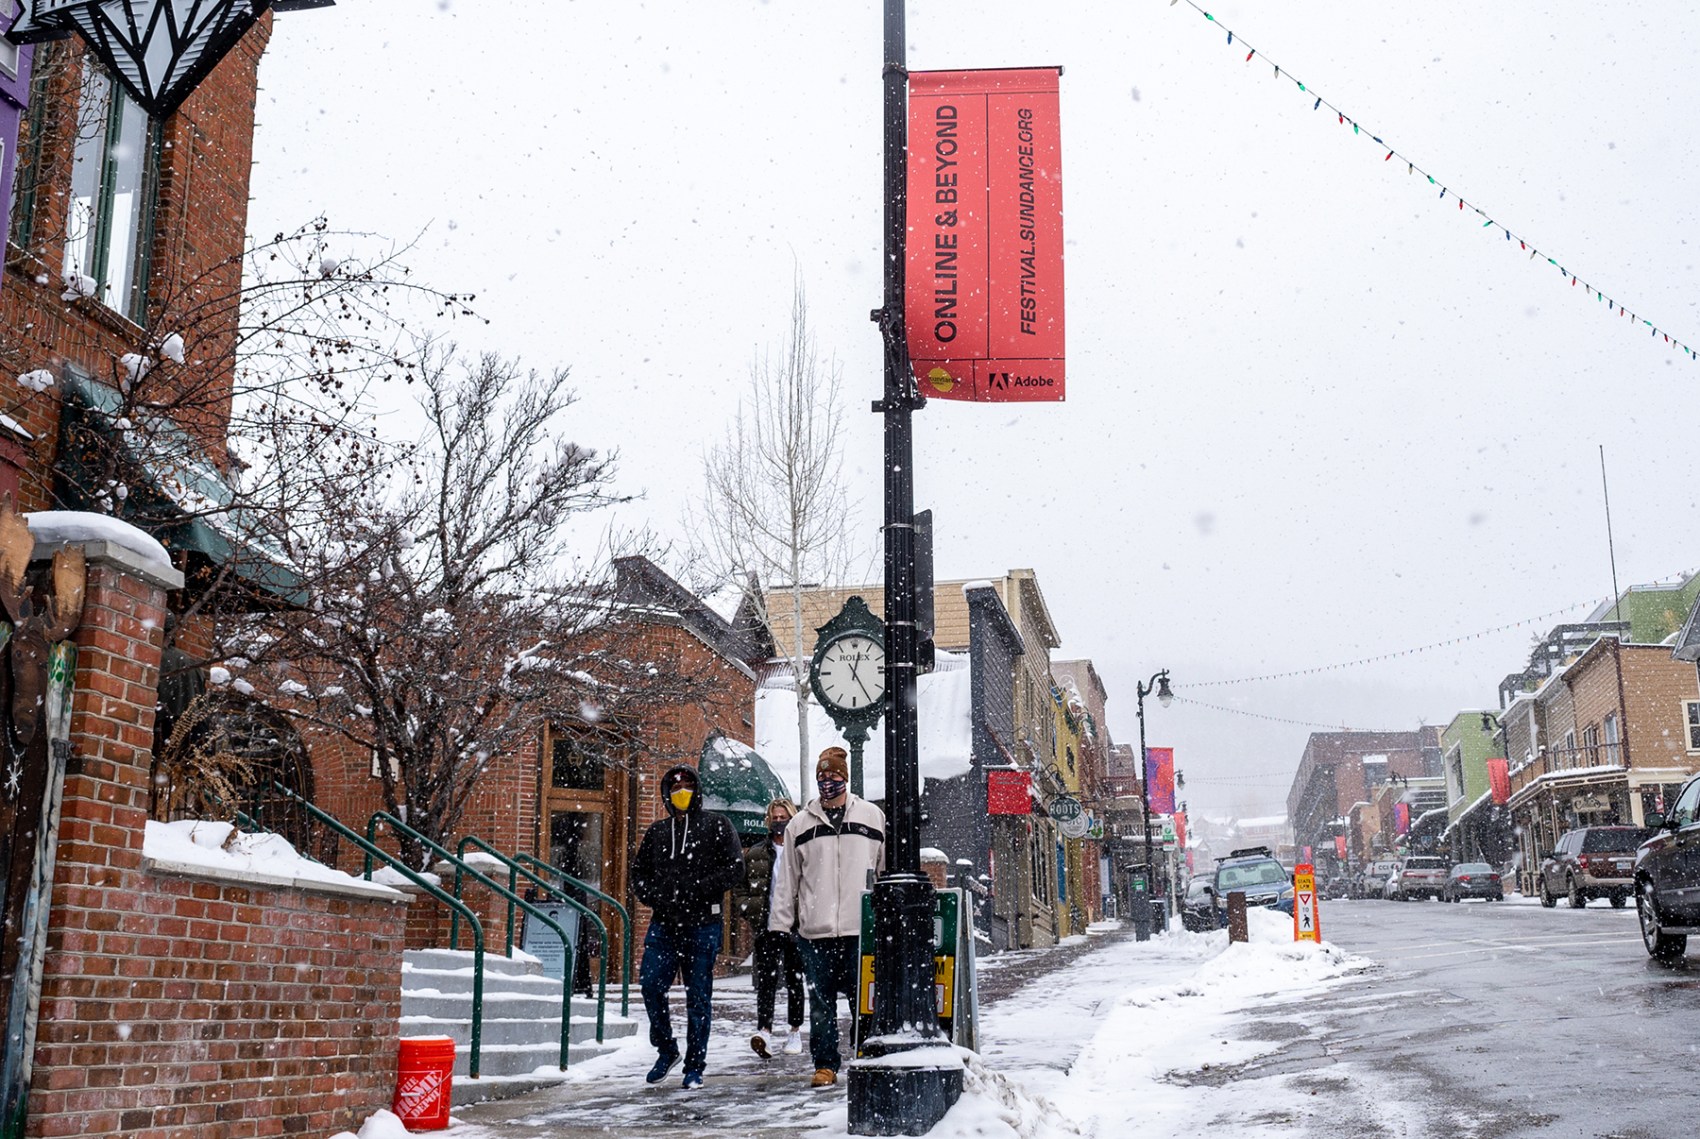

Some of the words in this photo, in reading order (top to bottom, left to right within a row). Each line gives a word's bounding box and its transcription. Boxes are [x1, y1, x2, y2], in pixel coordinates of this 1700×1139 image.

[935, 105, 958, 204] BEYOND
[936, 210, 958, 229] &
[1017, 108, 1037, 336] FESTIVAL.SUNDANCE.ORG
[934, 235, 958, 343] ONLINE
[1014, 375, 1054, 387] Adobe
[1049, 803, 1080, 815] ROOTS
[396, 1071, 441, 1119] HOME
[400, 1076, 419, 1093] THE
[410, 1088, 440, 1118] DEPOT
